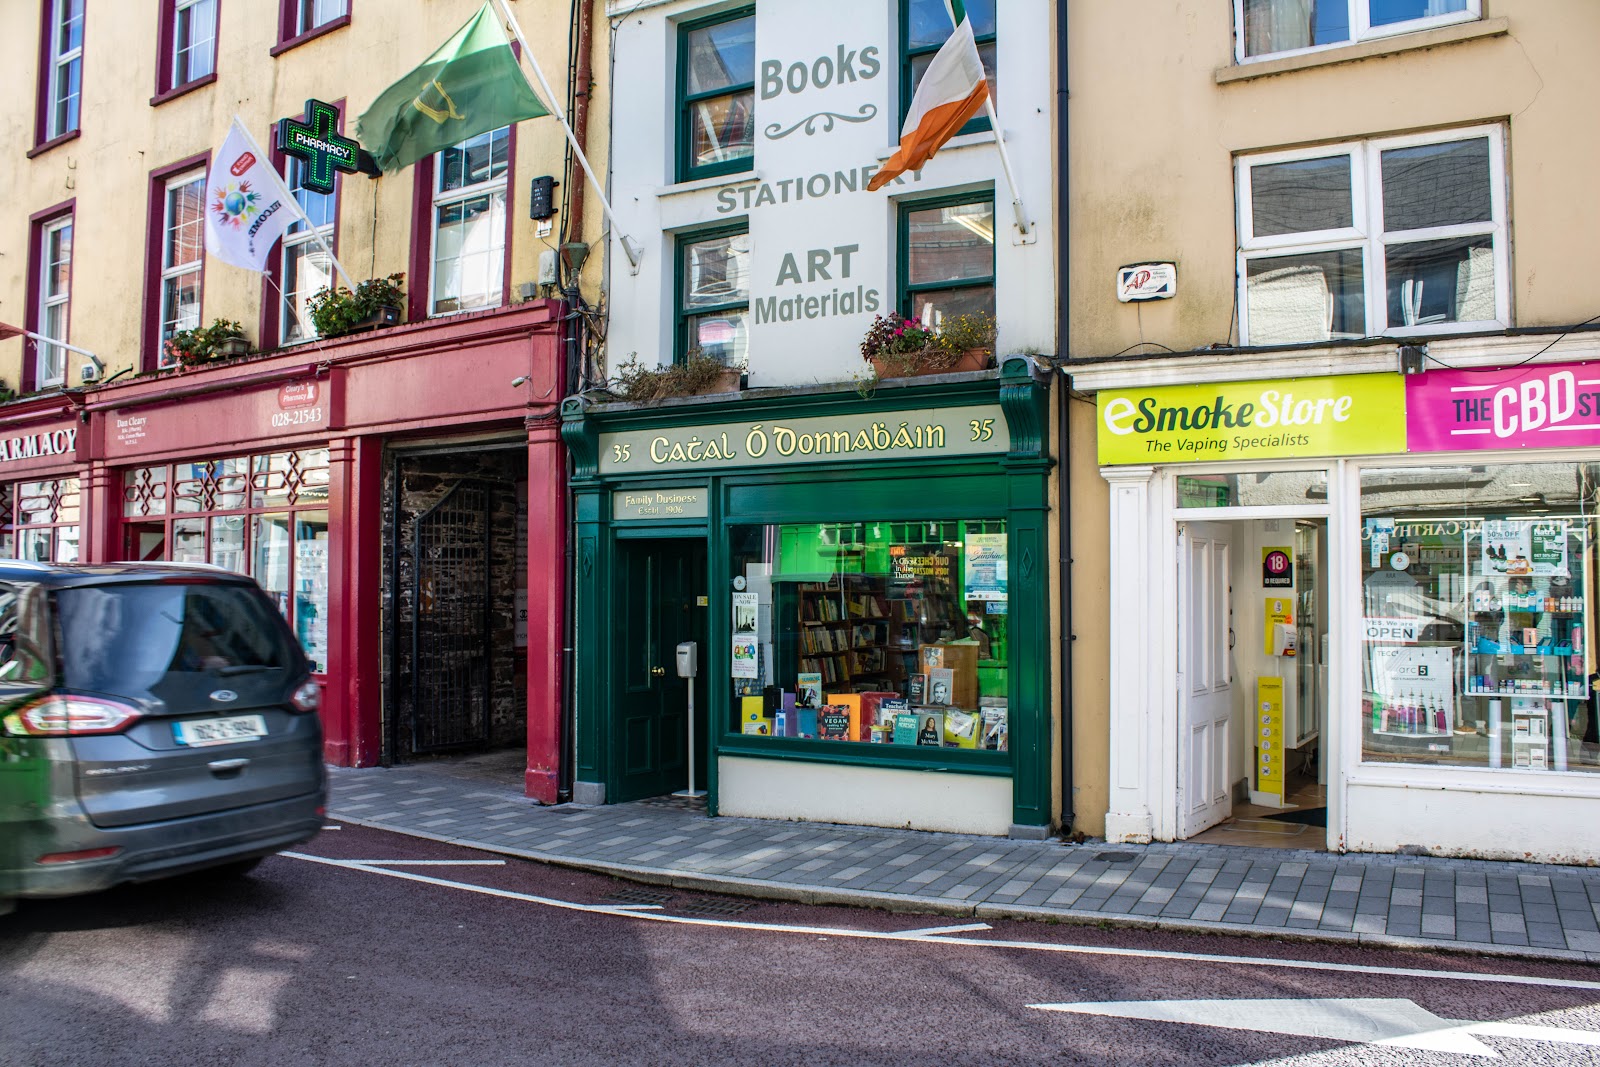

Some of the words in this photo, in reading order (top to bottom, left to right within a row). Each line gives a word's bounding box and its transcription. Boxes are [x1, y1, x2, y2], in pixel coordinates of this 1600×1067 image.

[760, 43, 881, 101] Books
[295, 132, 350, 159] PHARMACY
[775, 243, 859, 287] ART
[755, 285, 880, 325] Materials
[283, 393, 307, 402] Pharmacy
[1452, 397, 1492, 422] THE
[1493, 370, 1576, 438] CBD
[271, 407, 322, 427] 028-21543
[613, 444, 632, 463] 35
[745, 424, 769, 458] Ó
[969, 418, 995, 441] 35
[1146, 440, 1172, 452] The
[1177, 437, 1228, 454] Vaping
[1233, 434, 1310, 449] Specialists
[625, 495, 653, 507] Family
[665, 505, 683, 514] 1906
[1505, 530, 1520, 538] OFF
[1270, 555, 1284, 570] 18
[1367, 627, 1413, 639] OPEN
[1399, 666, 1416, 674] arc
[1419, 665, 1428, 675] 5
